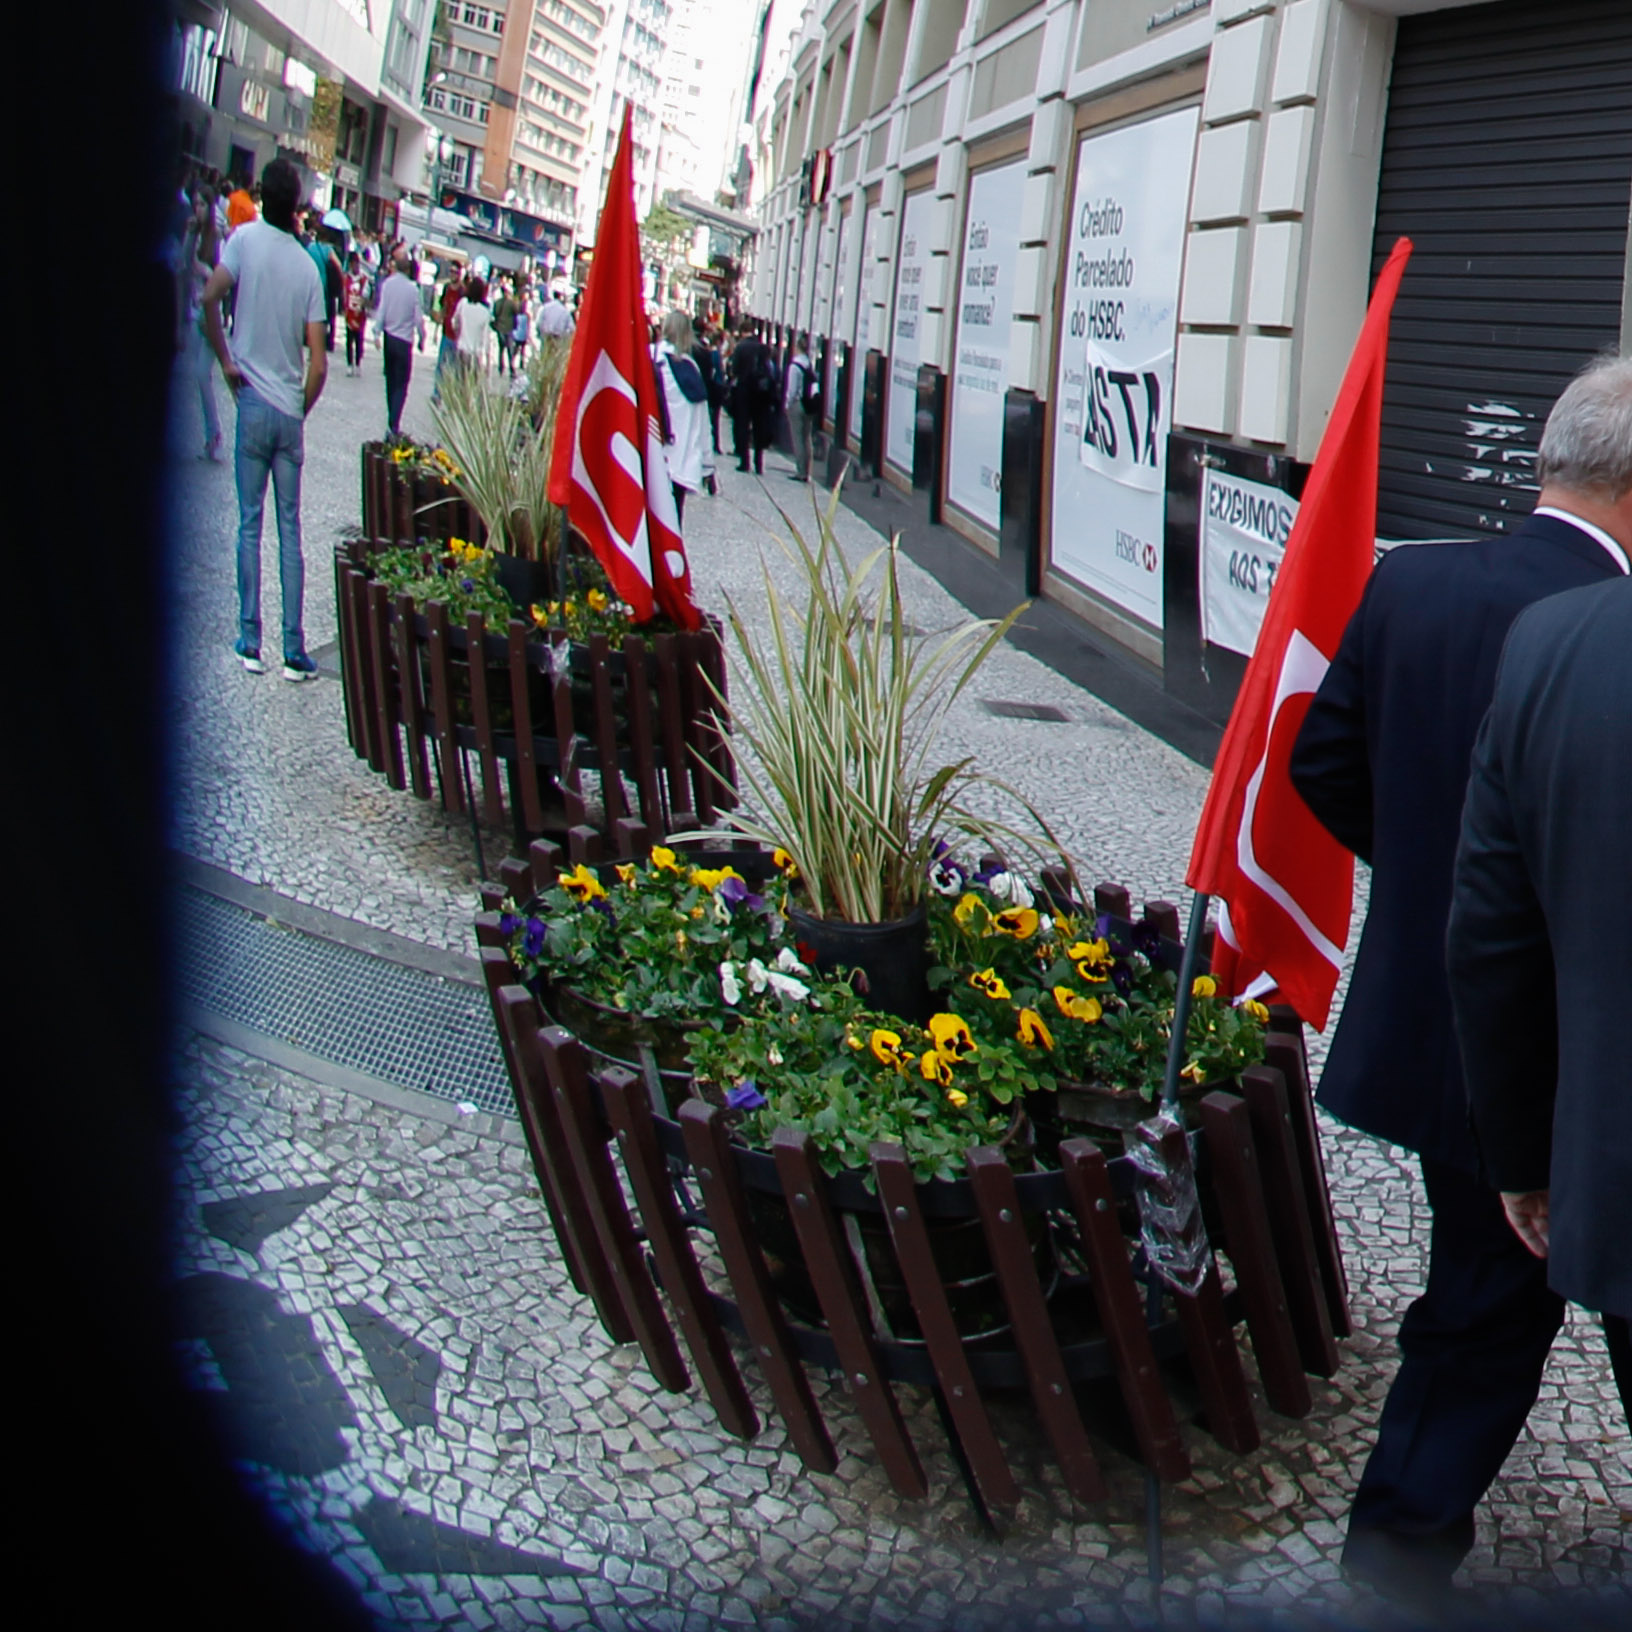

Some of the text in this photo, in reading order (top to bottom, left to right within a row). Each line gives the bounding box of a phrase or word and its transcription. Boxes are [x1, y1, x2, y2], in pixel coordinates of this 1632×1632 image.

[1080, 197, 1123, 239] Crédito
[1075, 247, 1134, 288] Parcelado
[1071, 301, 1086, 337] do
[1087, 300, 1126, 342] HSBC.
[1209, 482, 1293, 546] EXIGIMOS
[1229, 550, 1262, 594] AOS
